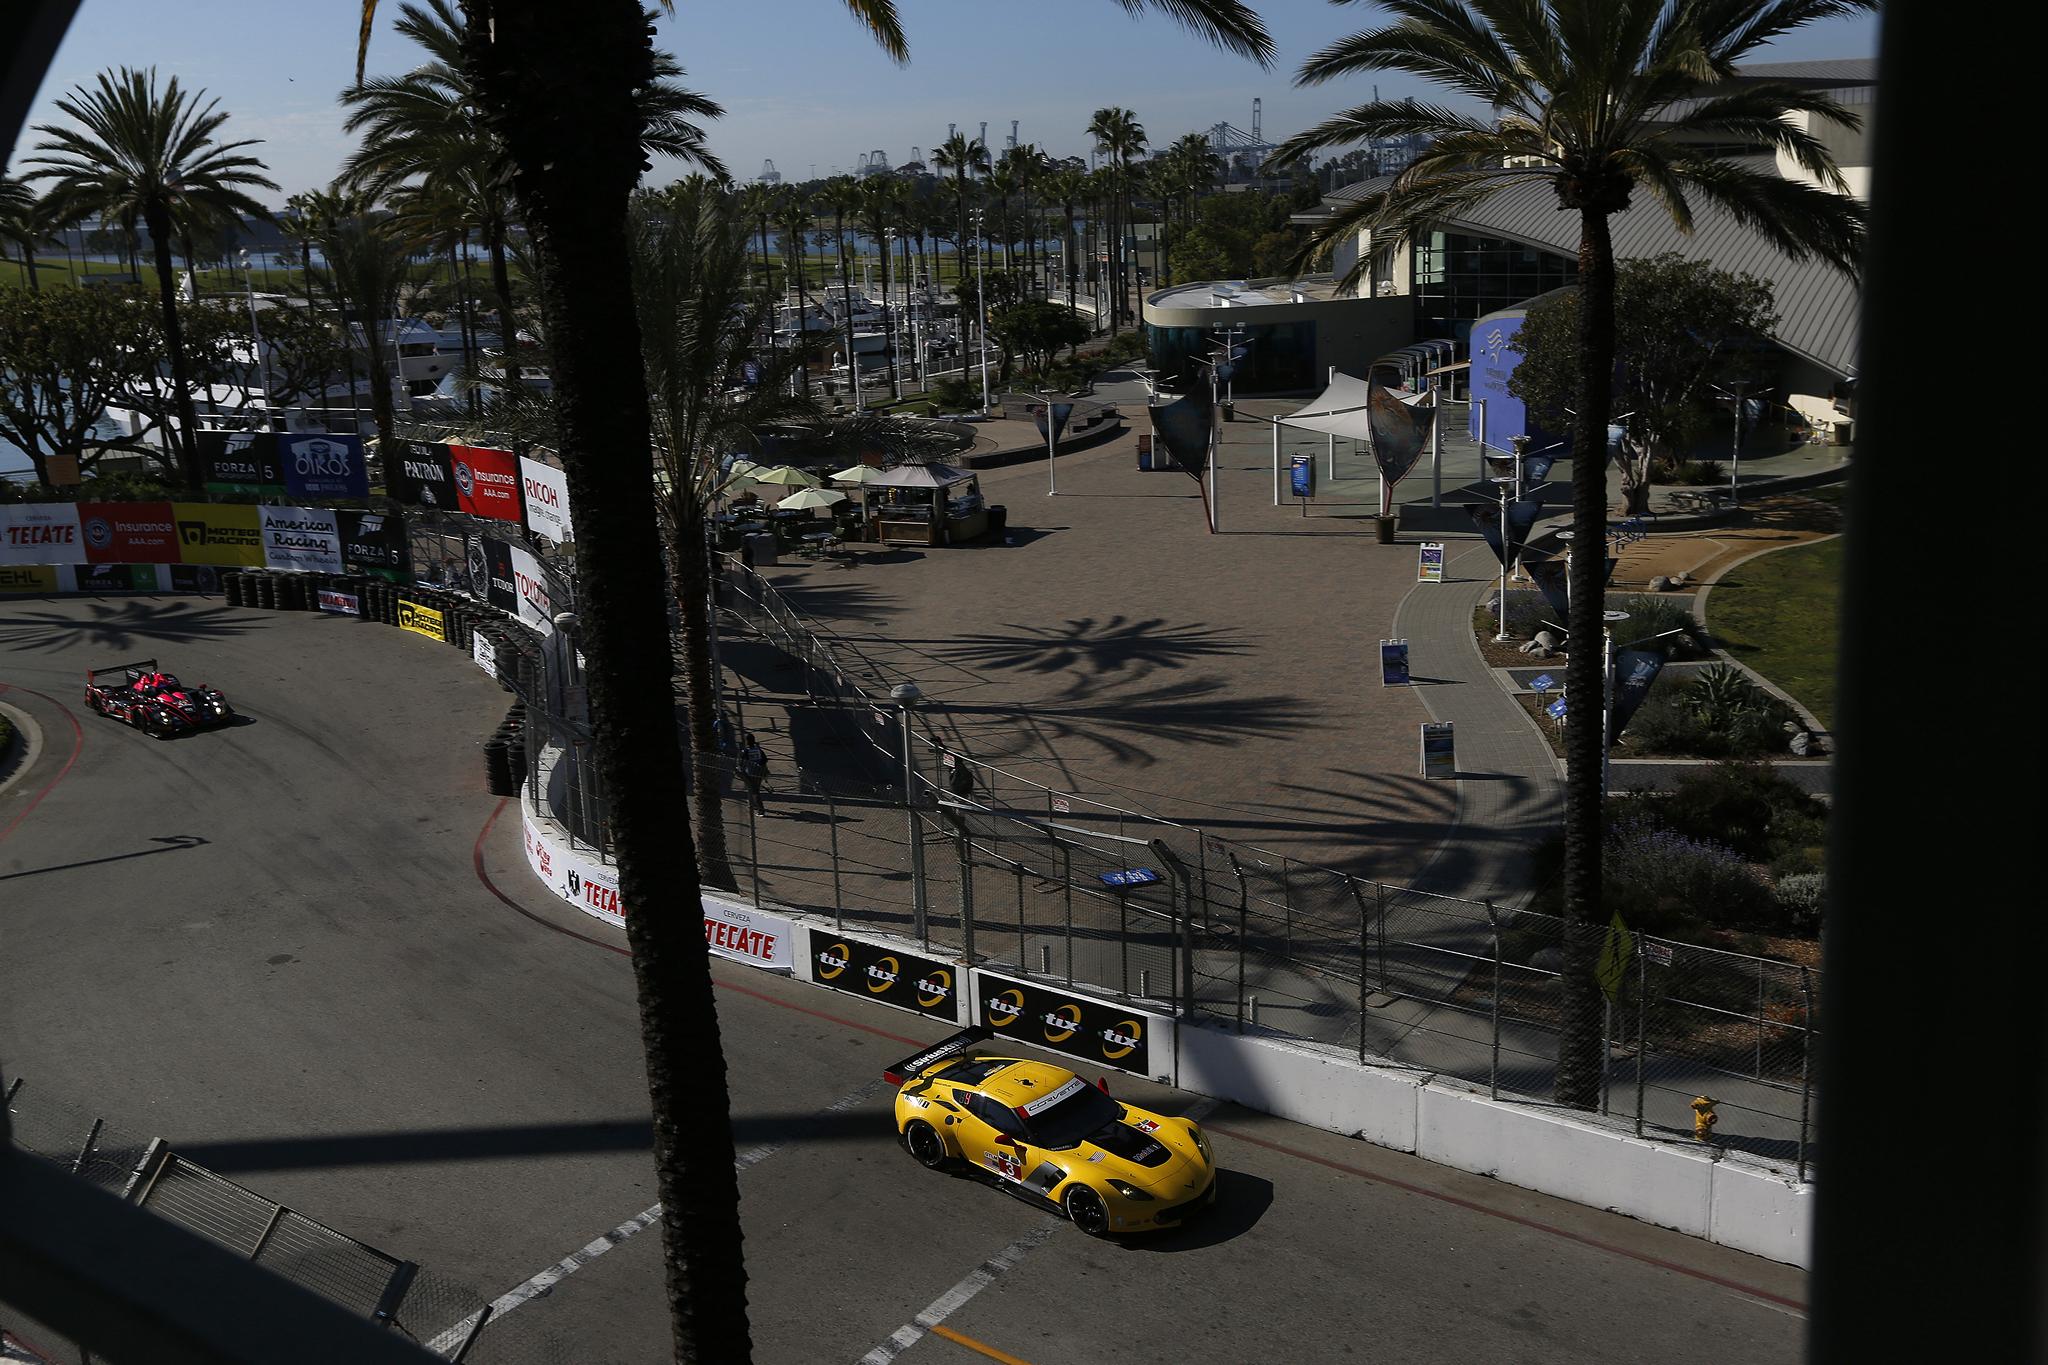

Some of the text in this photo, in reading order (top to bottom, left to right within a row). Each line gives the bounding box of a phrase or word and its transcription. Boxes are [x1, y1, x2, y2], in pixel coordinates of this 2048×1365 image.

[213, 462, 256, 473] FORZA
[264, 465, 275, 480] 5
[295, 457, 351, 477] OIKOS
[403, 460, 445, 482] PATRÓN
[473, 467, 515, 485] Insurance
[483, 489, 510, 499] AAA.com
[525, 477, 560, 509] RICOH
[115, 521, 173, 533] Insurance
[207, 528, 260, 536] MOTEGI
[265, 515, 334, 532] American
[8, 525, 74, 544] TECATE
[207, 537, 260, 546] RACING
[273, 532, 329, 555] Racing
[347, 543, 387, 558] FORZA
[391, 550, 400, 565] 5
[584, 880, 628, 917] TECAT
[723, 909, 751, 923] CERVEZA
[703, 918, 777, 961] TECATE
[819, 951, 848, 970] tix
[867, 964, 898, 983] tix
[918, 978, 949, 997] tix
[989, 997, 1022, 1017] tix
[1045, 1012, 1081, 1032] tix
[1103, 1028, 1139, 1049] tix
[1028, 1079, 1081, 1112] CORVETTE
[1005, 1161, 1015, 1176] 3
